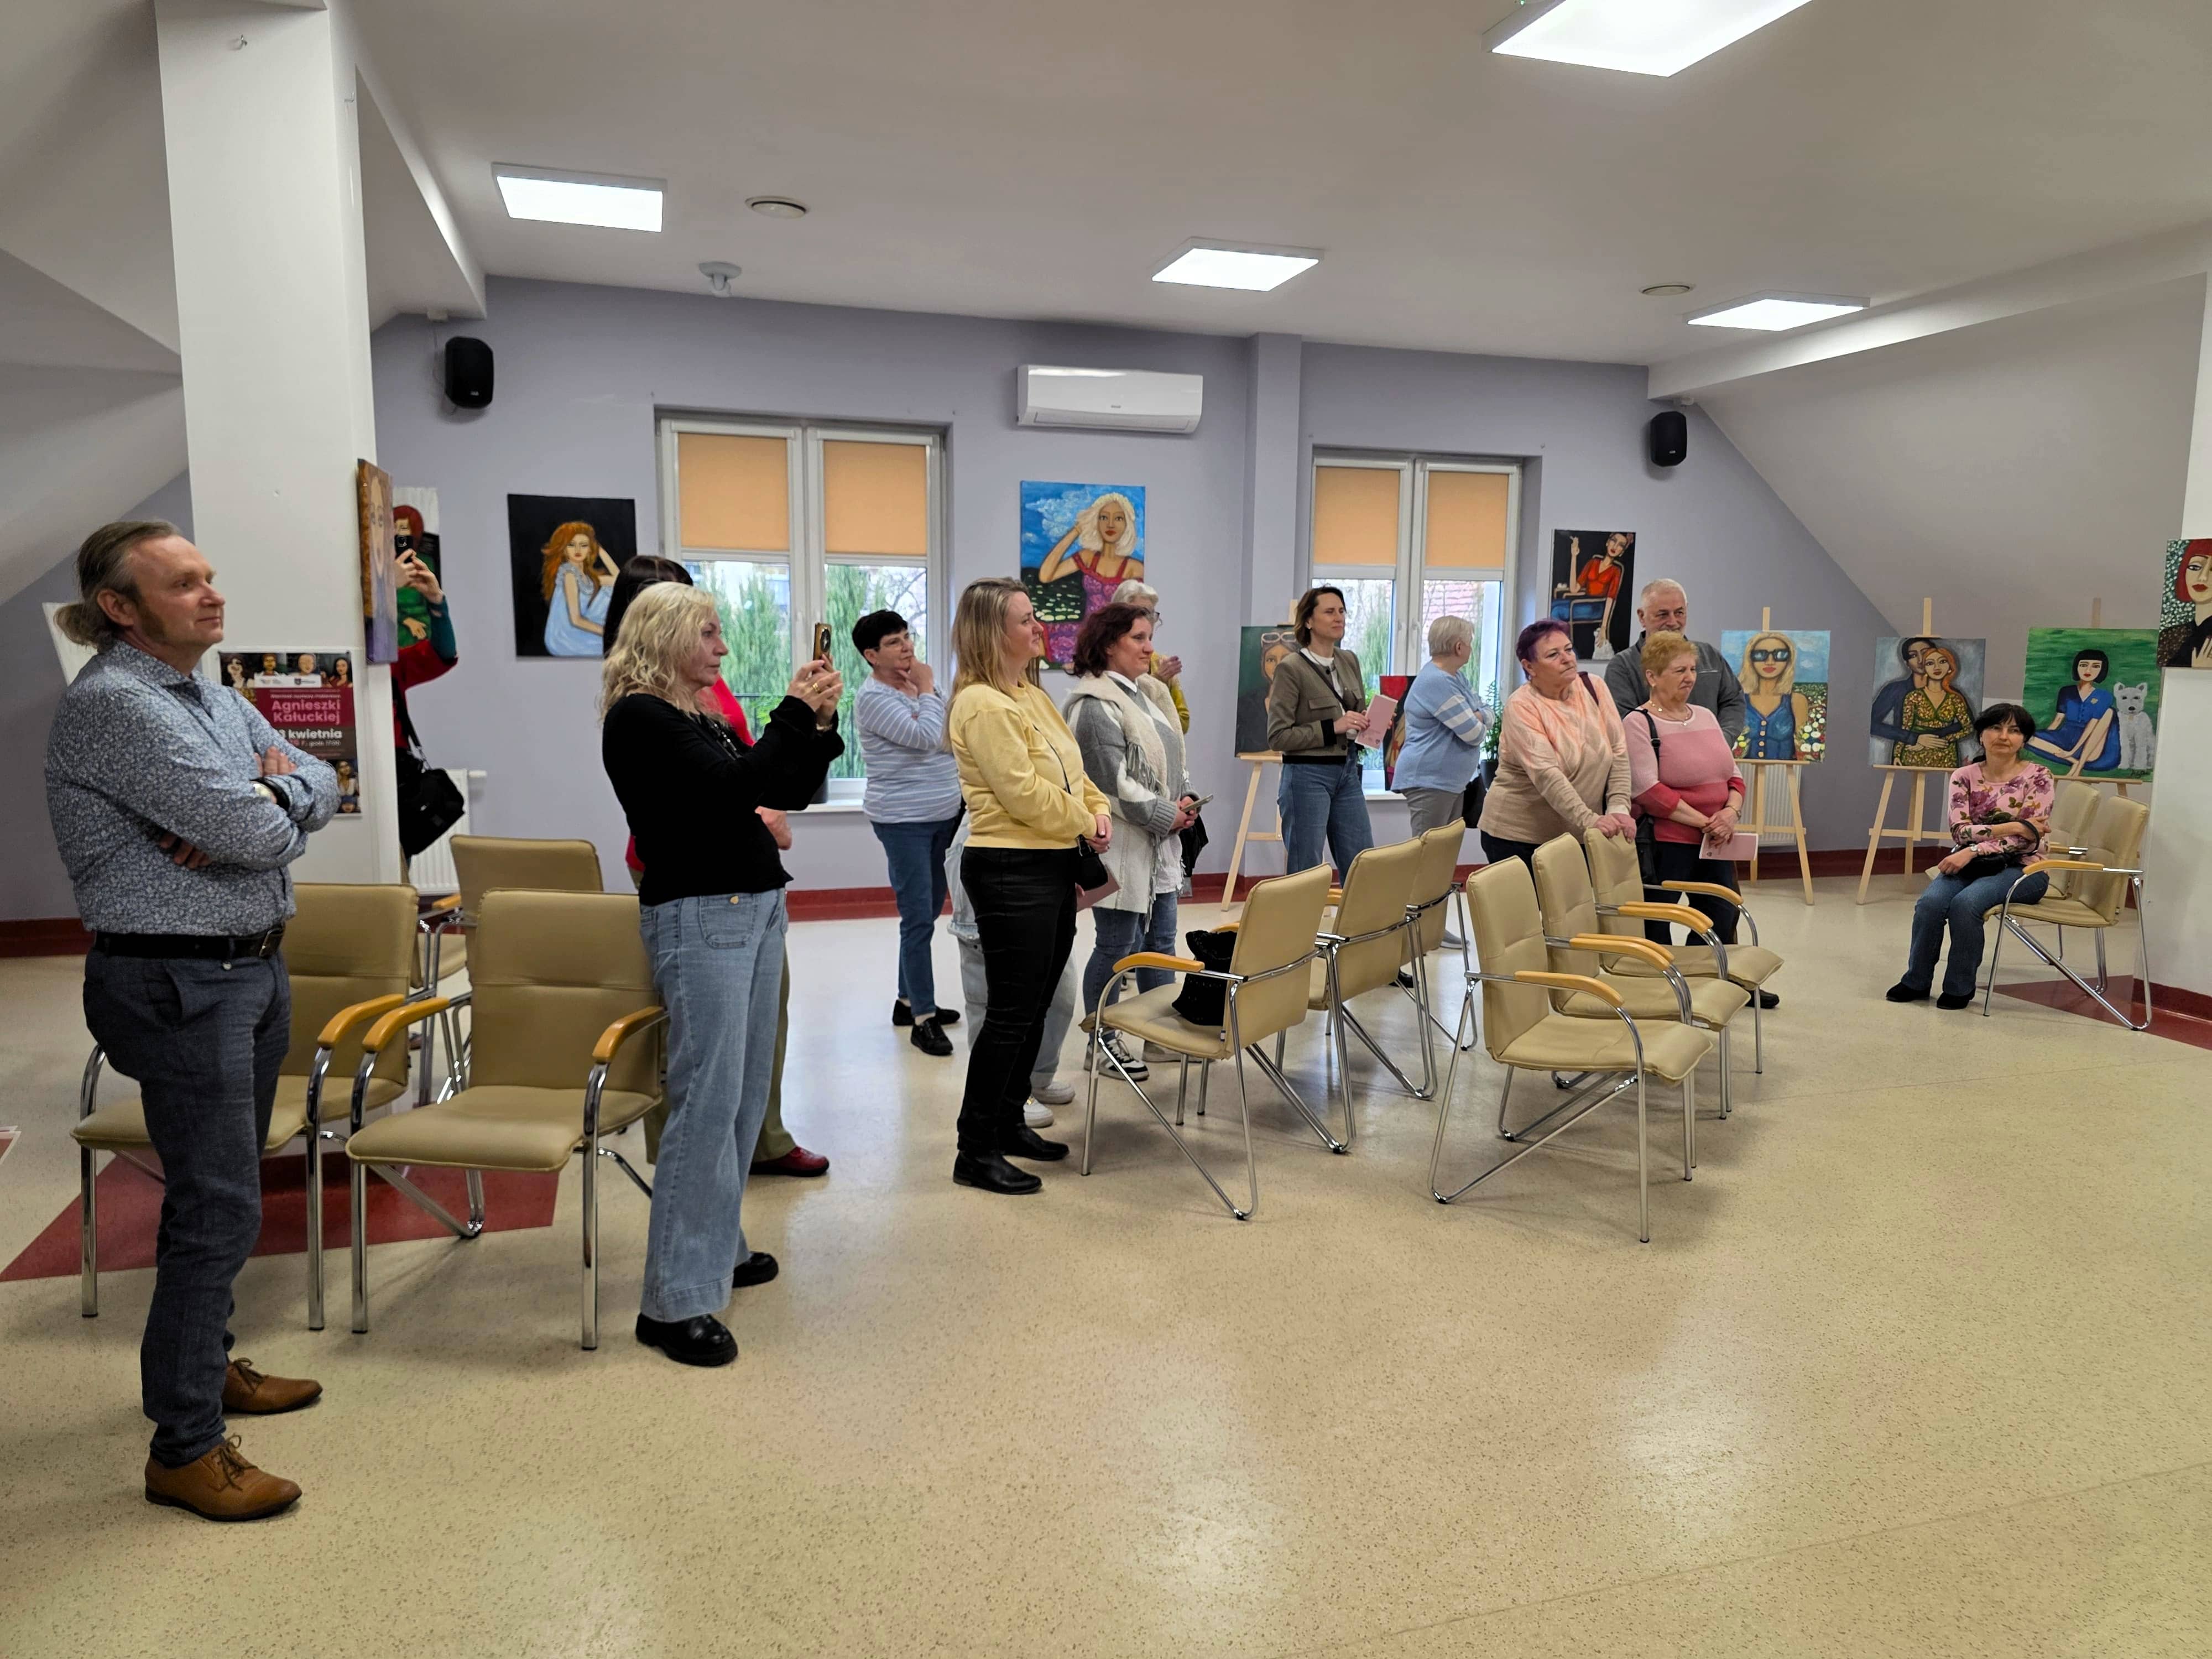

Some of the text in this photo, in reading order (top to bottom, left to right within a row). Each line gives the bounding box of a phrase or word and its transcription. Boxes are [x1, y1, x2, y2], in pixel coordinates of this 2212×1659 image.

[272, 699, 341, 713] Agnieszki
[273, 711, 340, 725] Kałuckiej
[288, 728, 342, 739] kwietnia
